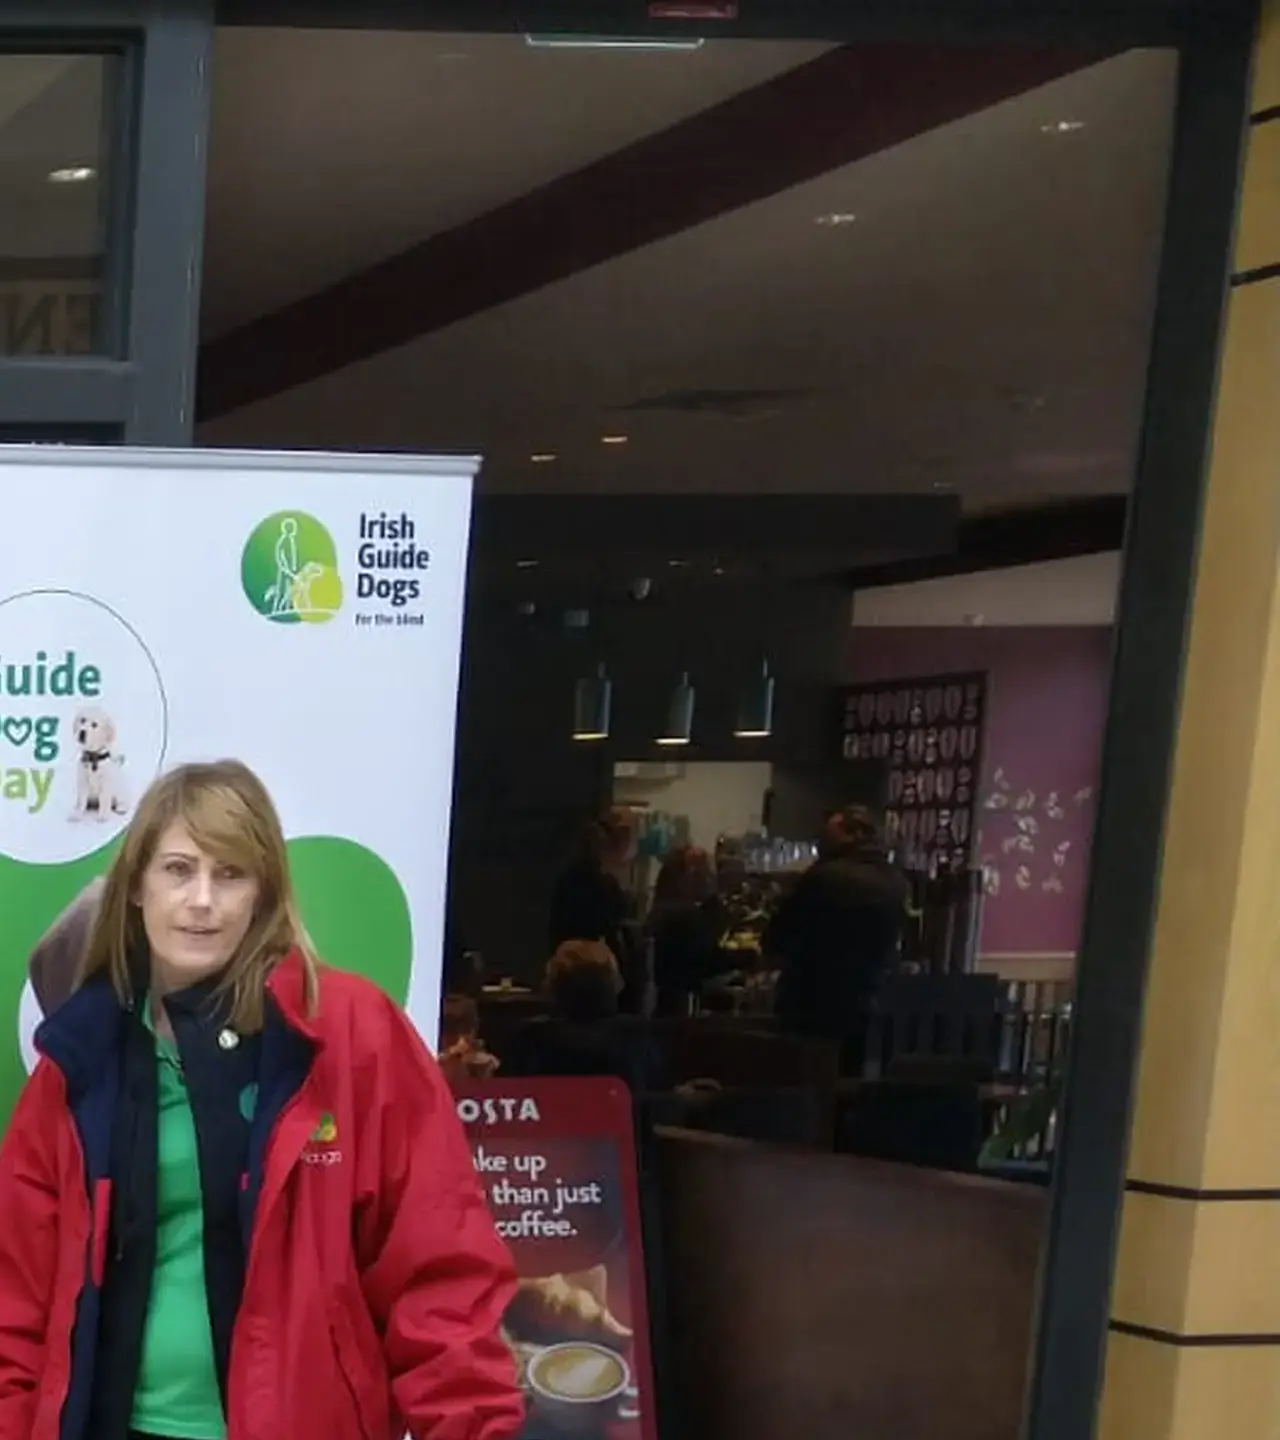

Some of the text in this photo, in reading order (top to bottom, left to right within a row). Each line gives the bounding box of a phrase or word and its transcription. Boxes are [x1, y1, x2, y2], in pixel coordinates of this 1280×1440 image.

[359, 511, 415, 539] Irish
[357, 541, 430, 570] Guide
[356, 572, 421, 608] Dogs
[513, 1154, 547, 1181] up
[492, 1178, 602, 1215] than just
[495, 1209, 578, 1237] coffee.
